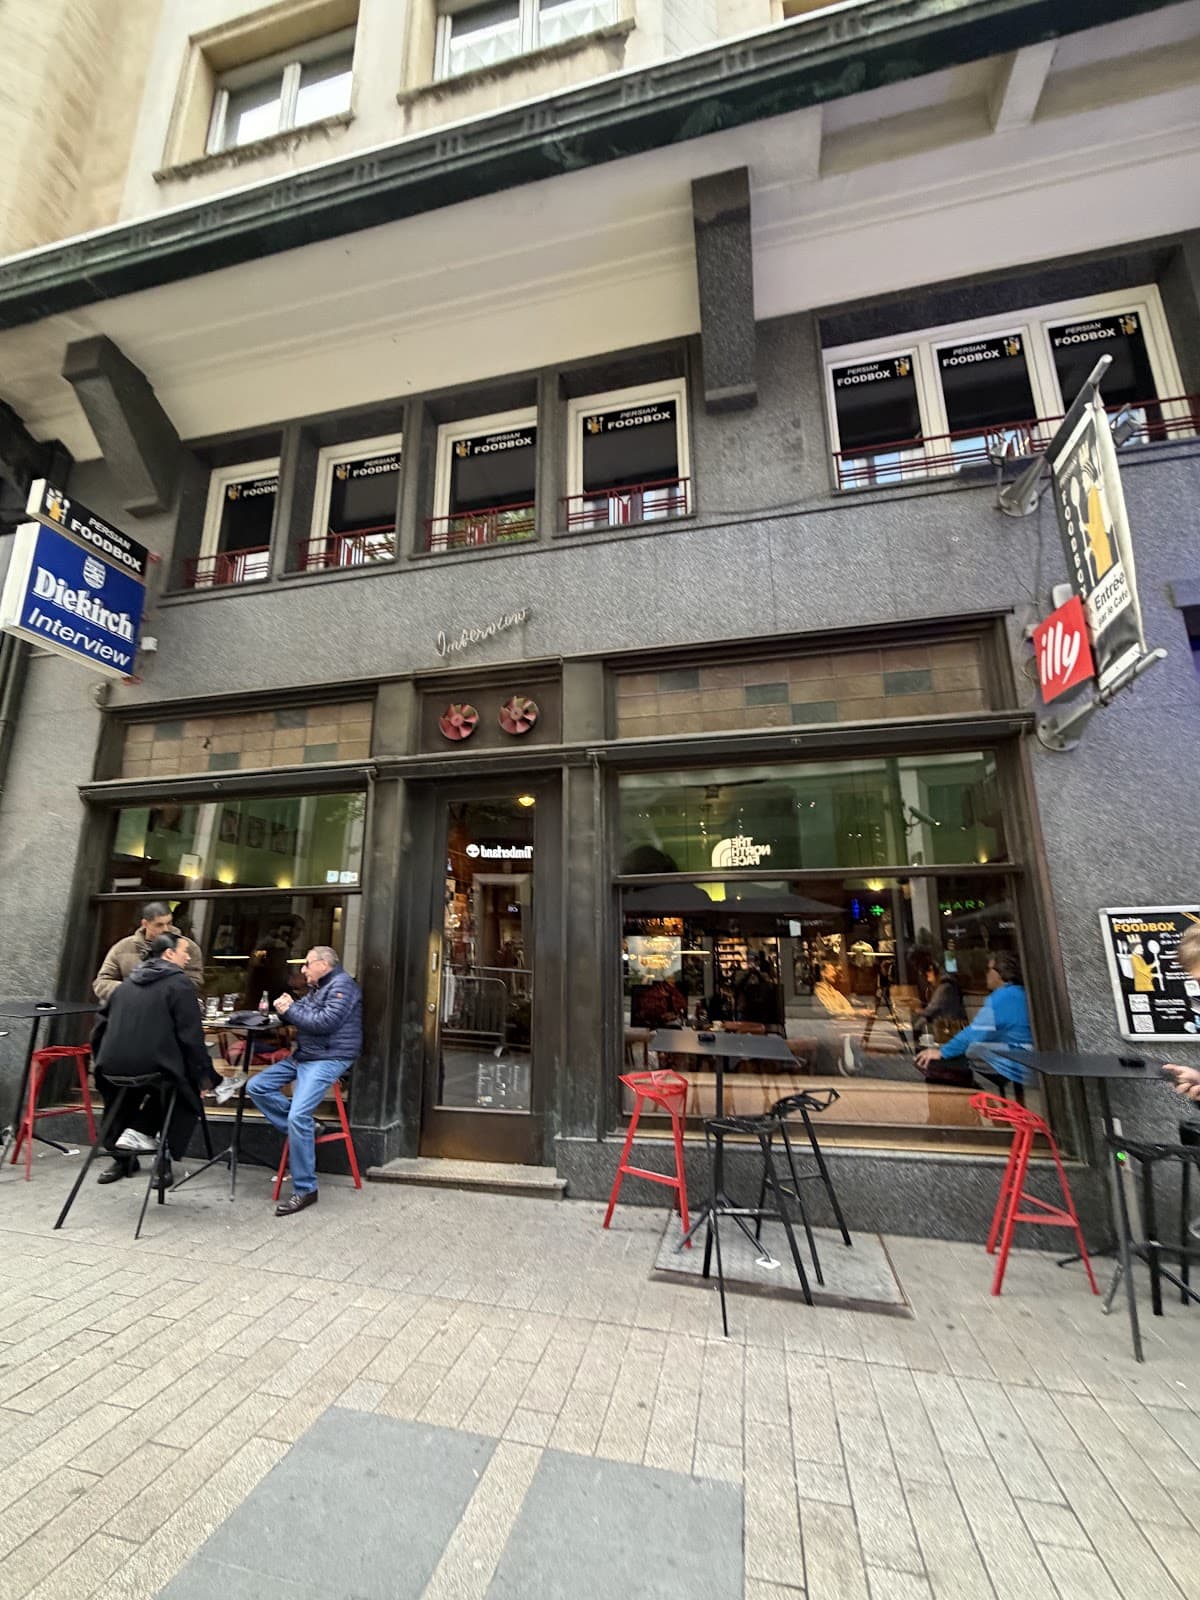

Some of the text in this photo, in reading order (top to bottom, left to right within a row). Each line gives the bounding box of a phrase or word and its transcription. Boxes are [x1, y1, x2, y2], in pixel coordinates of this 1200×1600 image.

[1054, 328, 1116, 347] FOODBOX
[1064, 323, 1102, 334] PERSIAN
[942, 349, 1000, 367] FOODBOX
[952, 344, 987, 355] PERSIAN
[837, 370, 891, 387] FOODBOX
[847, 364, 879, 375] PERSIAN
[607, 411, 671, 430] FOODBOX
[620, 406, 658, 418] PERSIAN
[474, 437, 532, 454] FOODBOX
[486, 432, 521, 443] PERSIAN
[88, 517, 131, 550] PERSIAN
[71, 518, 142, 573] FOODBOX
[1094, 572, 1125, 611] Entrée
[33, 566, 134, 641] Diekirch
[28, 607, 130, 667] Interview
[1041, 621, 1080, 685] illy
[1113, 922, 1176, 933] FOODBOX
